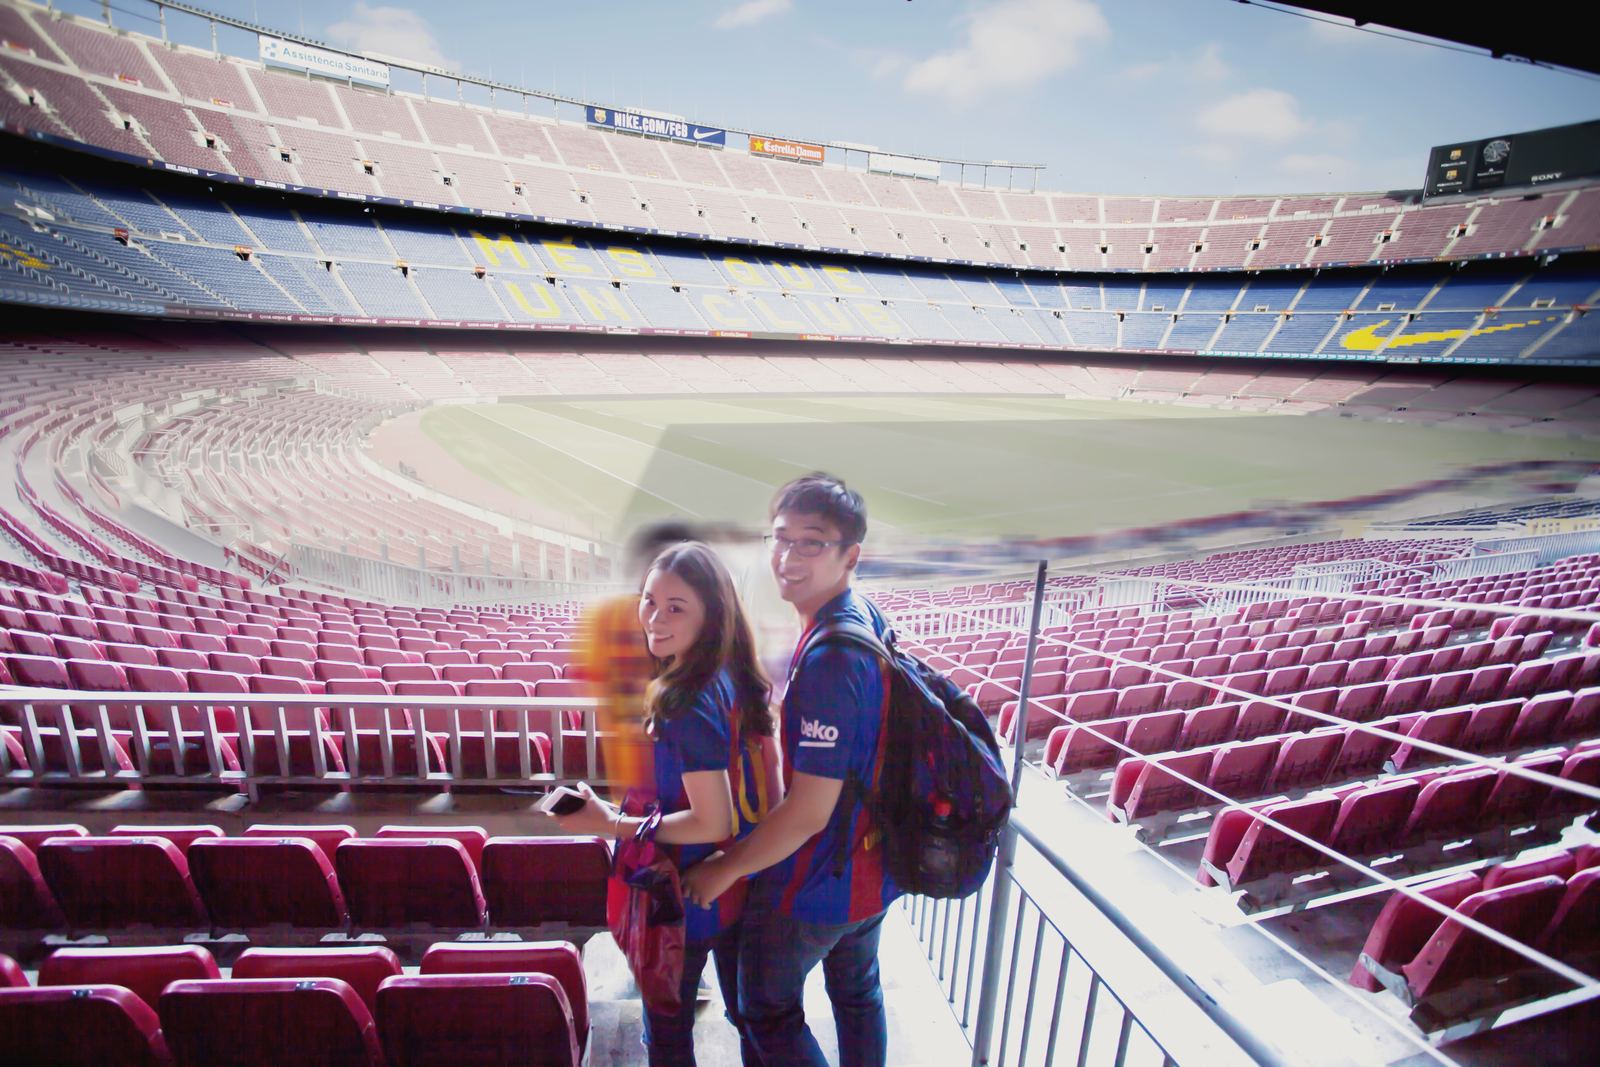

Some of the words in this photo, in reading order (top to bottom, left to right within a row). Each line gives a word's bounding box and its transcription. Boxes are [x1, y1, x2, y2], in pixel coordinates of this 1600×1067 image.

[614, 112, 688, 138] NIKE.COM/FCB
[764, 140, 795, 155] Estrella
[796, 145, 821, 158] Damm
[1531, 172, 1563, 181] SONY
[724, 257, 865, 292] QUE
[506, 282, 631, 321] UN
[801, 716, 839, 741] beko
